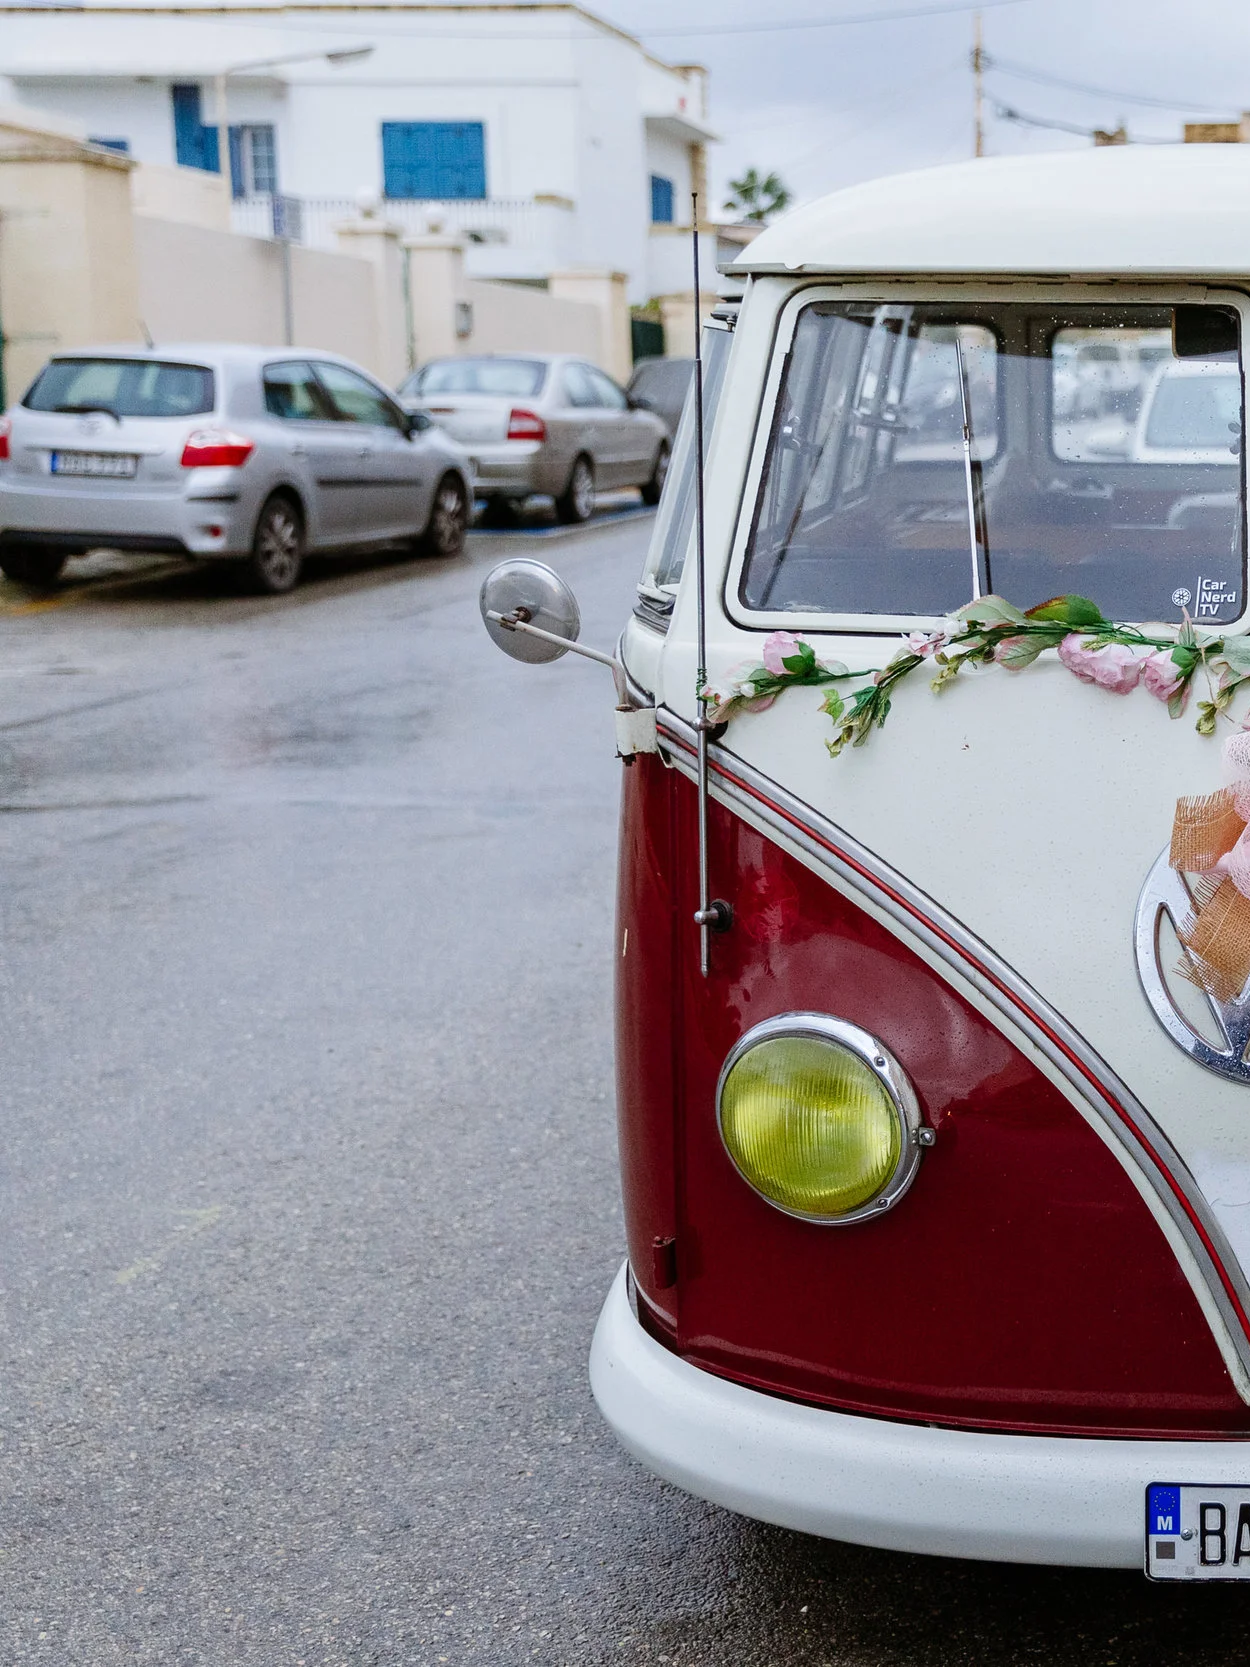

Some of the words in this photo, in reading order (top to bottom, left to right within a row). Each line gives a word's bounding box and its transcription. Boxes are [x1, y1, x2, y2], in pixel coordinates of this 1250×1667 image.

[1202, 579, 1227, 591] Car
[1201, 591, 1237, 603] Nerd
[1199, 603, 1220, 615] TV
[1156, 1515, 1173, 1531] M
